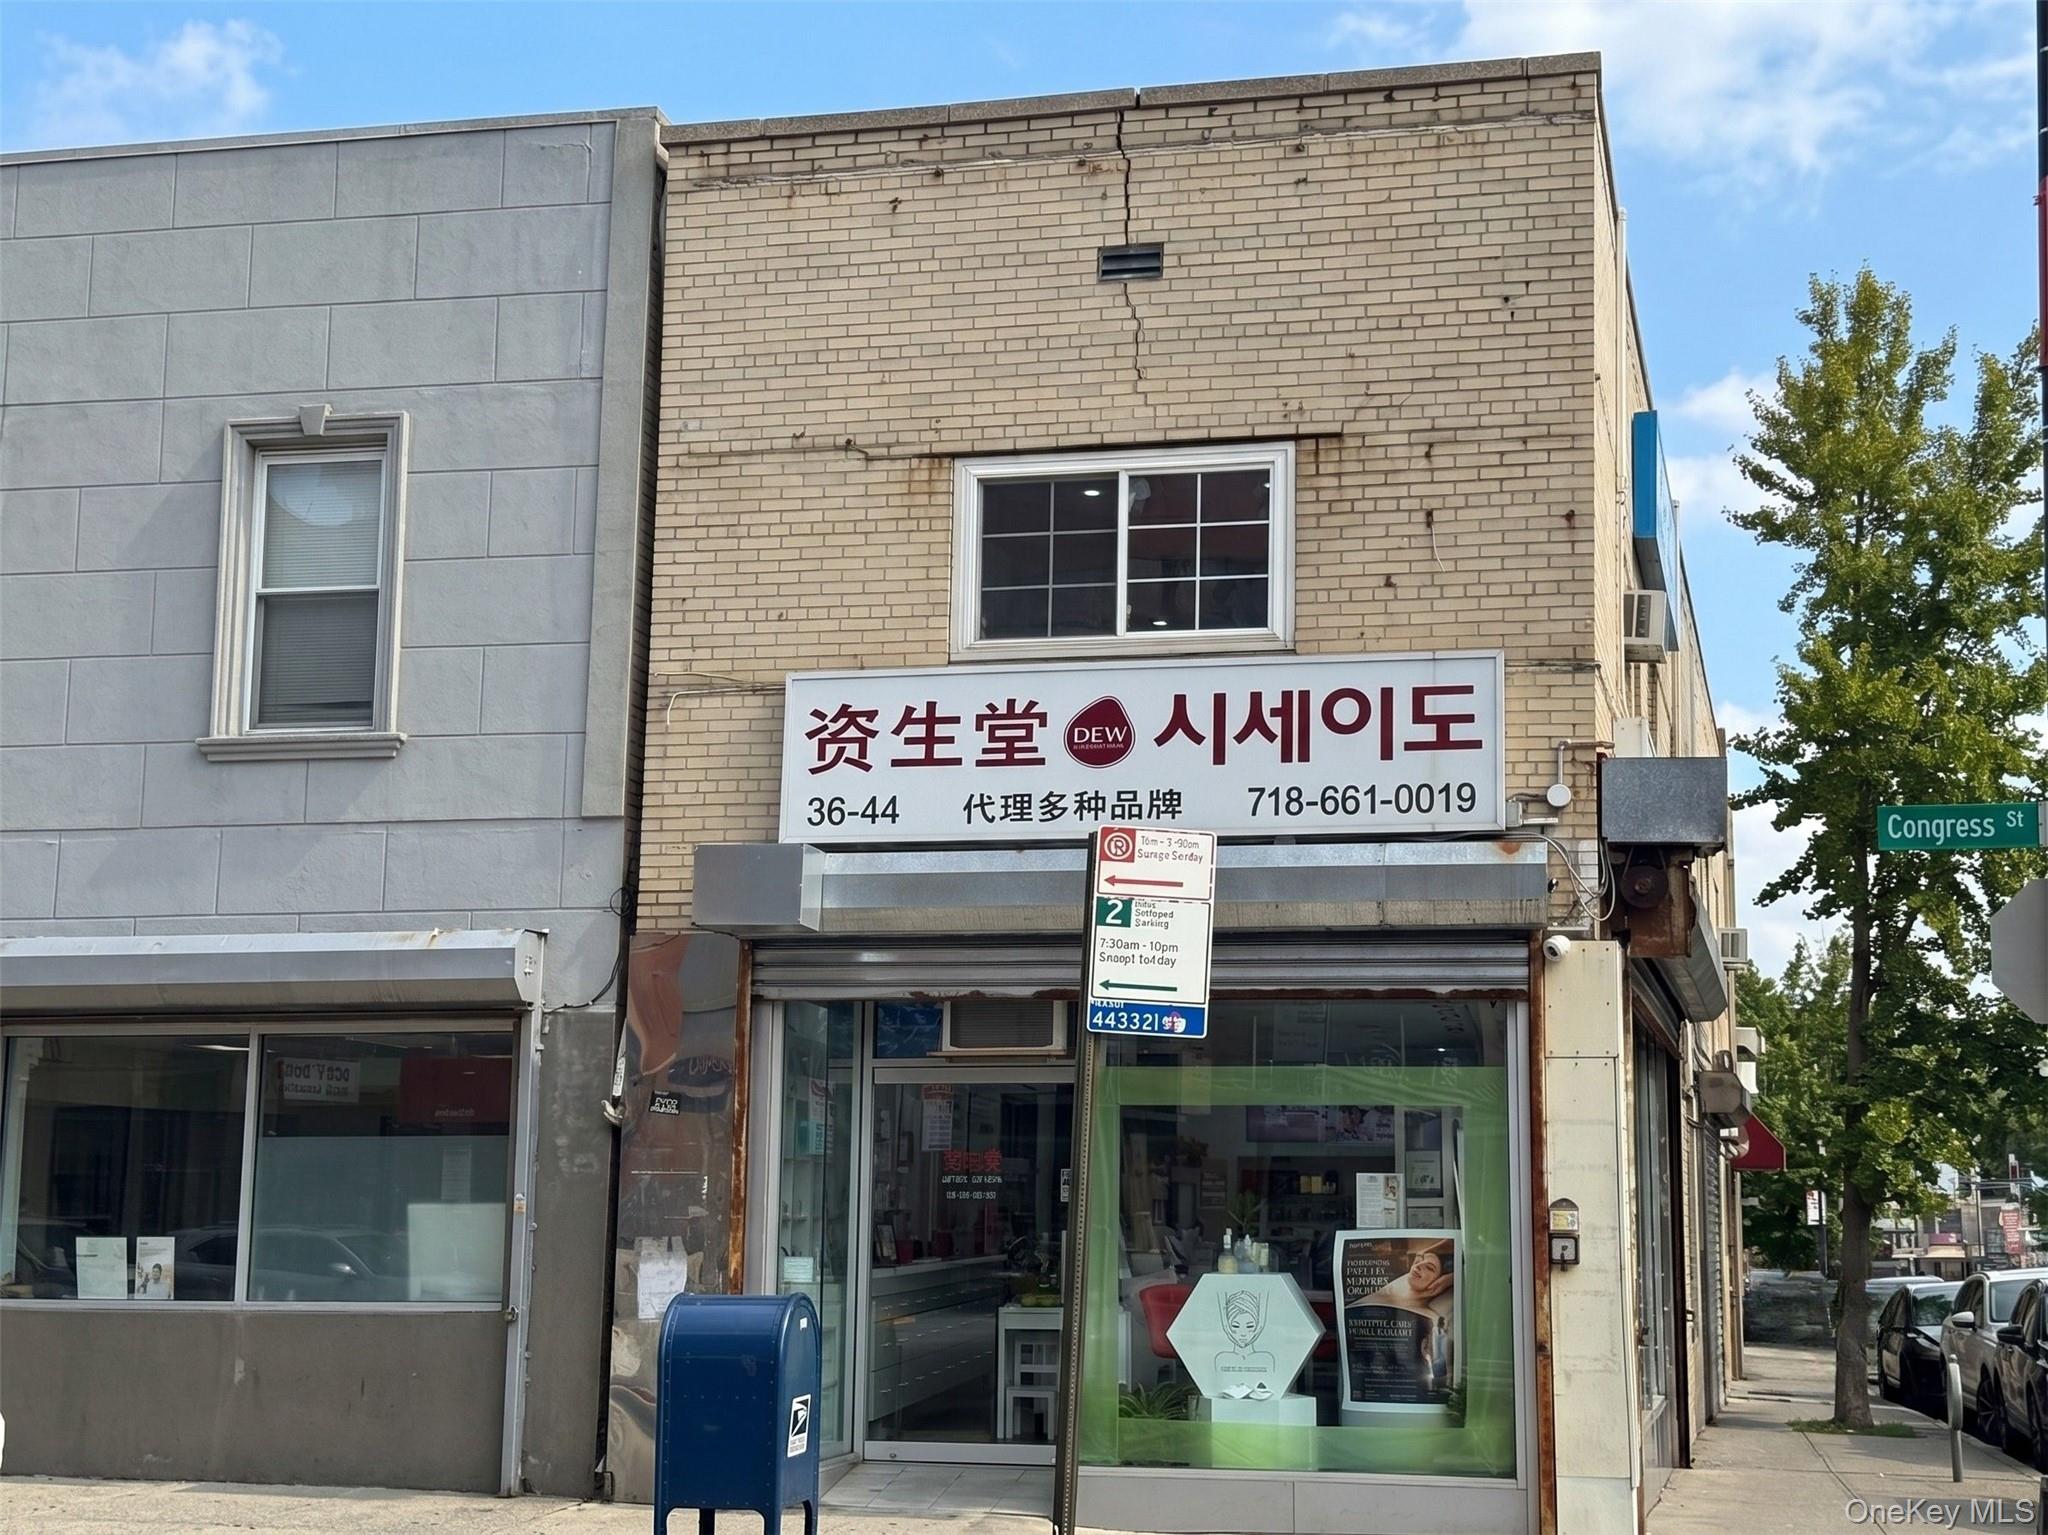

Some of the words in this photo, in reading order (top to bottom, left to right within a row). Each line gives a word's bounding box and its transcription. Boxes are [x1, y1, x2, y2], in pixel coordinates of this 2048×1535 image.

[804, 697, 1048, 776] 资生堂
[1073, 726, 1128, 743] DEW
[1153, 684, 1484, 766] 시세이도
[806, 795, 900, 826] 36-44
[962, 788, 1184, 824] 代理多种品牌
[1248, 782, 1477, 817] 718-661-0019
[1887, 814, 1996, 846] Congress
[2006, 810, 2025, 828] St
[1105, 899, 1123, 925] 2
[1100, 938, 1140, 950] 7:30am
[1149, 941, 1179, 953] 10pm
